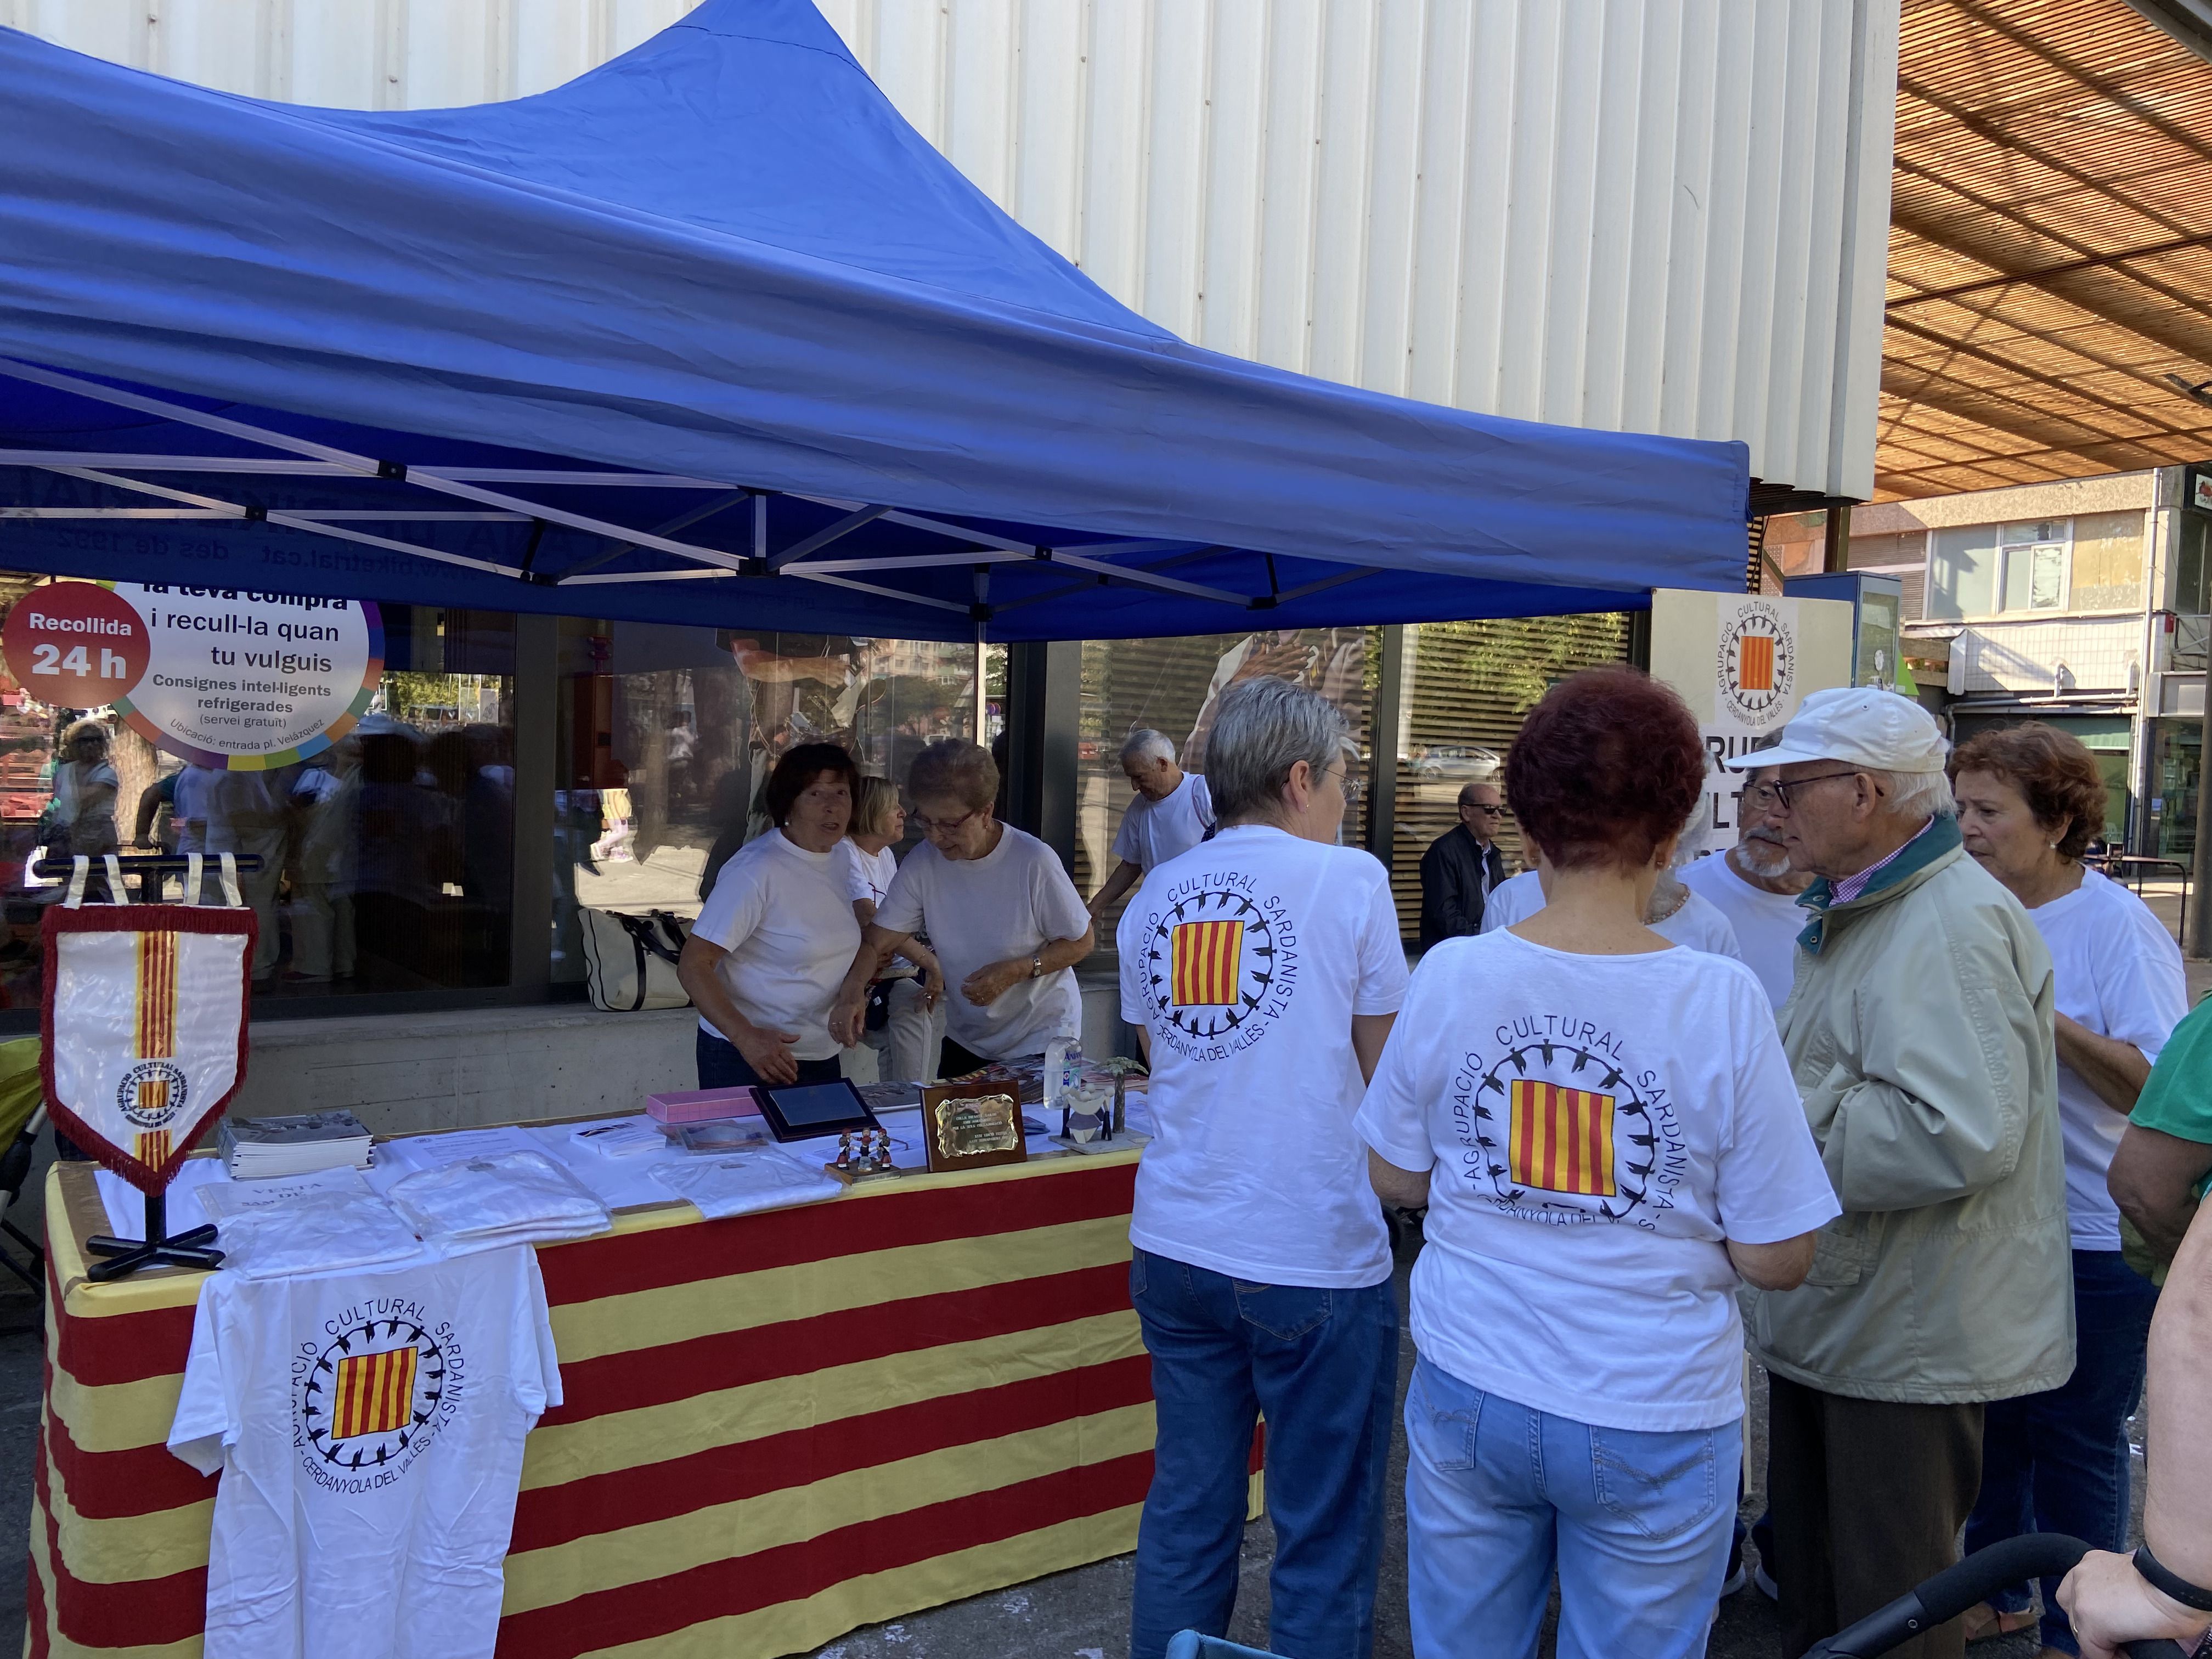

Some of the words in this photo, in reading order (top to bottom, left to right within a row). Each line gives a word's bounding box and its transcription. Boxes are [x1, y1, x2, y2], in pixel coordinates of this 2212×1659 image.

[29, 612, 132, 636] Recollida
[151, 608, 156, 627] i
[167, 613, 268, 636] recull-la
[278, 622, 338, 642] quan
[32, 644, 92, 677] 24
[100, 648, 126, 679] h
[211, 647, 235, 666] tu
[245, 651, 332, 674] vulguis
[1718, 621, 1733, 695] AGRUPACIÓ
[1737, 602, 1779, 622] CULTURAL
[1781, 623, 1795, 695] SARDANISTA
[153, 674, 237, 691] Consignes
[198, 697, 293, 713] refrigerades
[1727, 701, 1755, 726] CERDANYOLA
[1757, 715, 1766, 725] DEL
[1767, 702, 1784, 722] VALLÈS
[170, 719, 216, 746] Ubicació:
[219, 740, 260, 750] entrada
[264, 740, 276, 751] pl.
[277, 719, 325, 746] Velázquez
[200, 714, 240, 726] (servei
[244, 716, 286, 729] gratuït)
[1138, 912, 1160, 1020] AGRUPACIÓ
[1167, 872, 1257, 901] CULTURAL
[1263, 896, 1298, 1019] SARDANISTA
[1207, 1045, 1229, 1061] DEL
[1454, 1052, 1482, 1180] AGRUPACIÓ
[1496, 1015, 1623, 1061] CULTURAL
[1637, 1070, 1687, 1210] SARDANISTA
[252, 1183, 324, 1194] VENTA
[325, 1298, 425, 1335] CULTURAL
[435, 1322, 464, 1432] SARDANISTA
[303, 1457, 371, 1494] CERDANYOLA
[375, 1470, 399, 1488] DEL
[398, 1436, 431, 1474] VALLÈS
